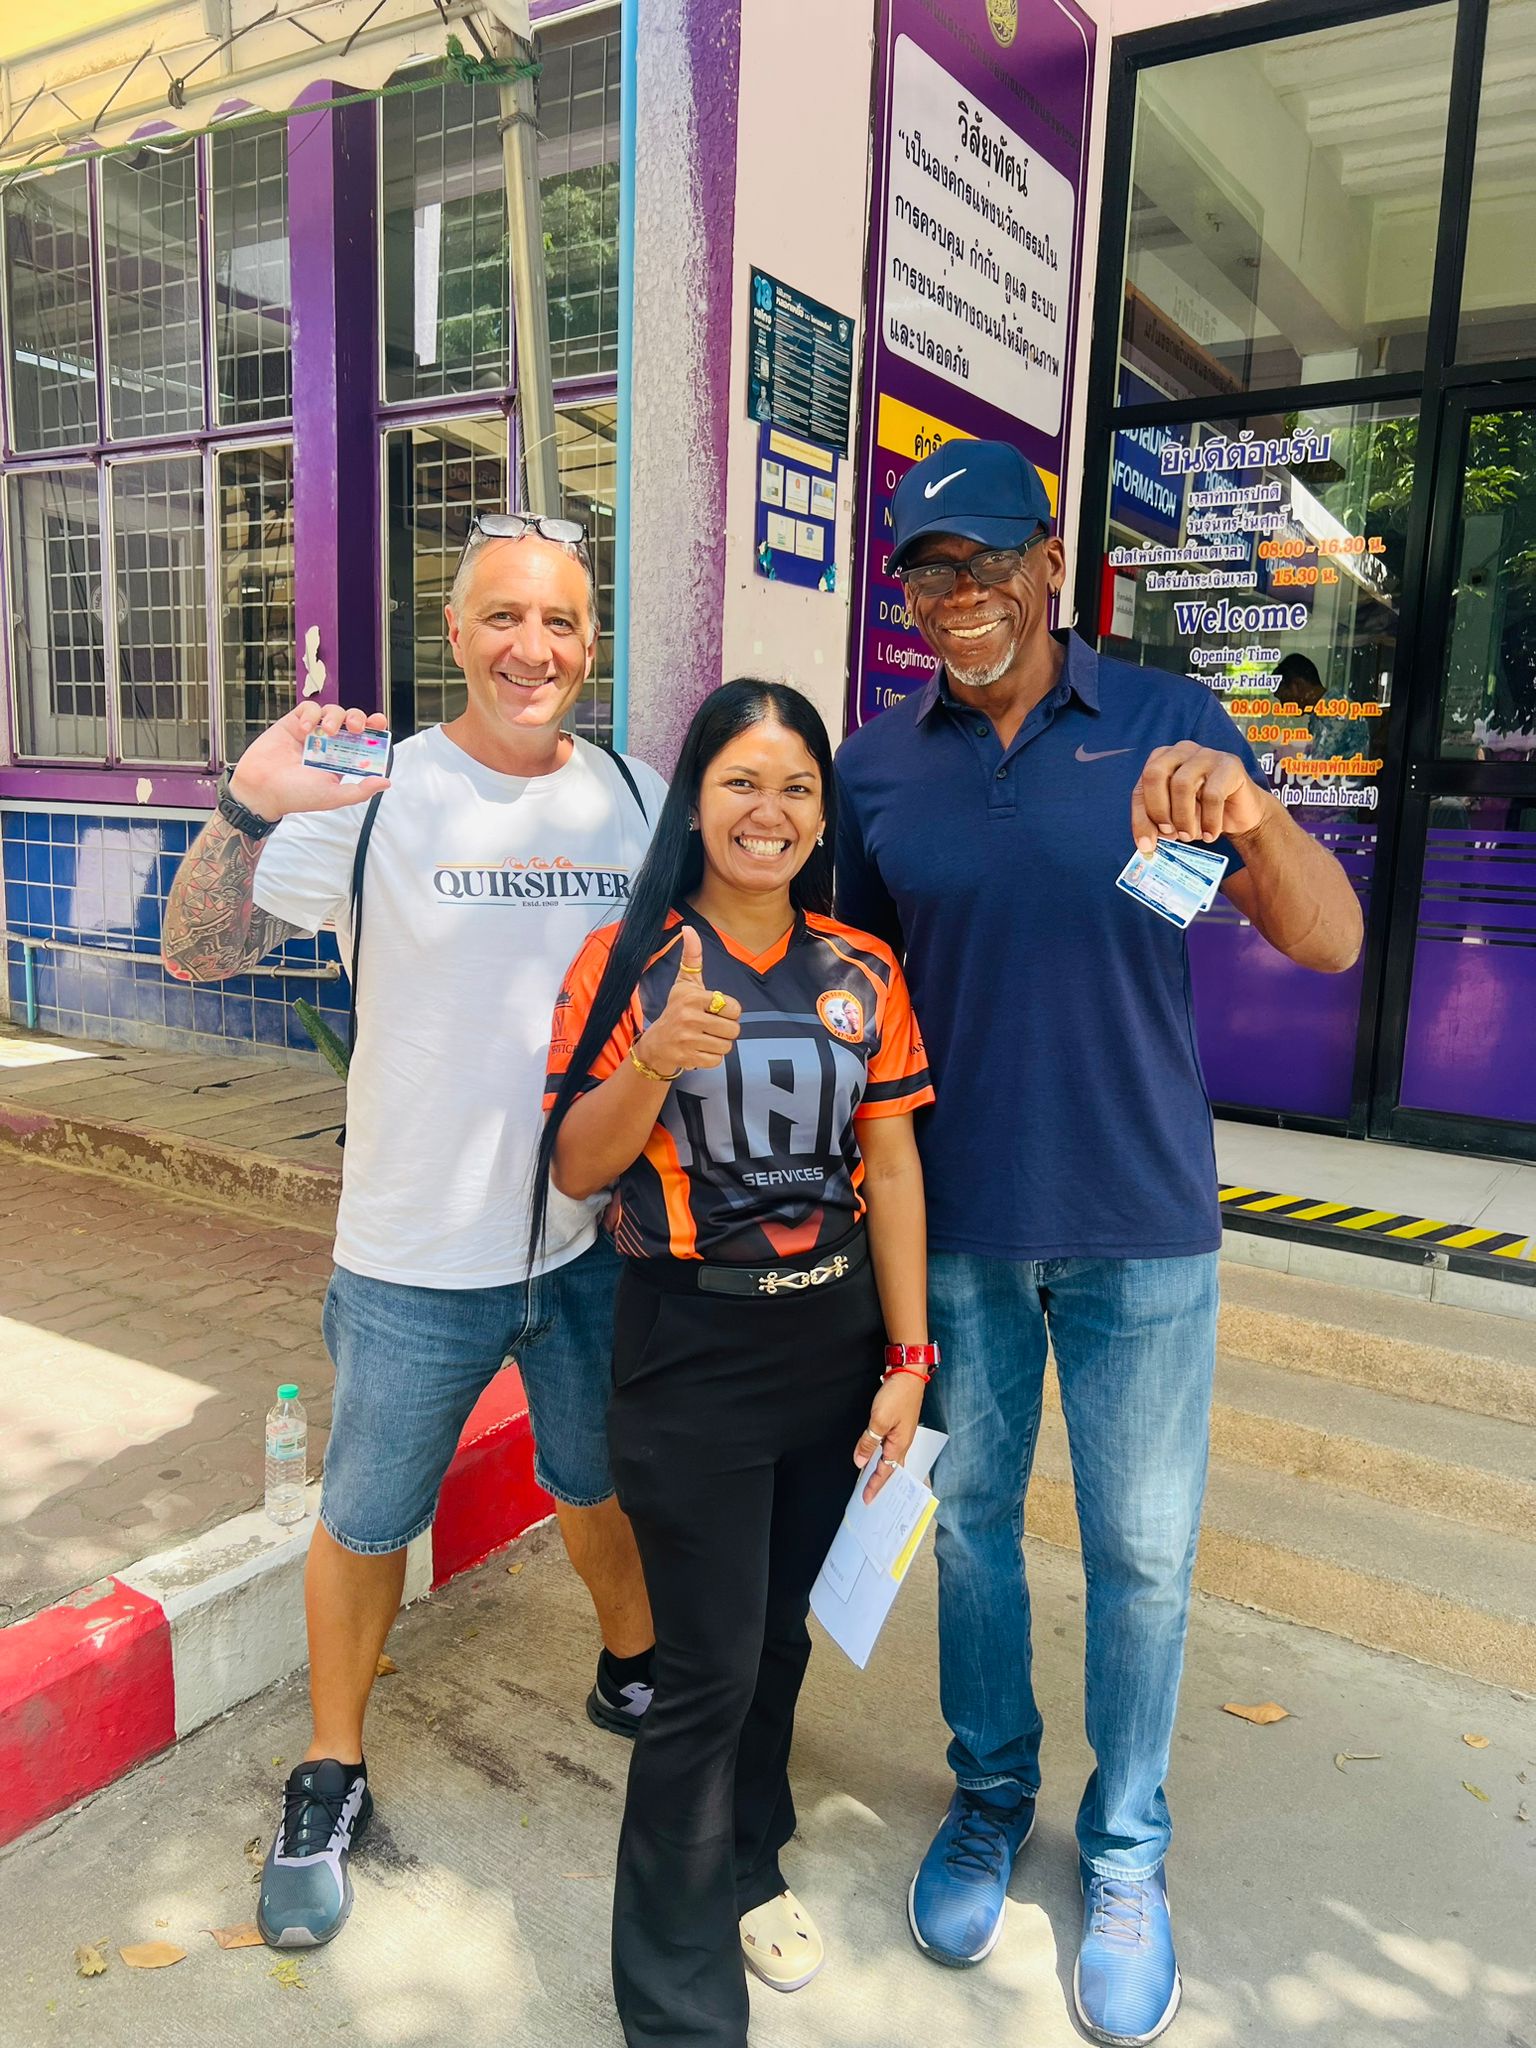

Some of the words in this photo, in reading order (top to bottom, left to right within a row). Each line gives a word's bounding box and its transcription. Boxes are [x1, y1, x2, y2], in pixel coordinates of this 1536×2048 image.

[957, 100, 1029, 198] วิสัยทัศน์
[895, 194, 966, 267] การควบคุม
[969, 244, 1001, 285] กำกับ
[1004, 271, 1027, 305] ดูแล
[1031, 291, 1058, 324] ระบบ
[892, 255, 1060, 378] การขนส่งทางถนนให้มีคุณภาพ
[889, 316, 970, 380] และปลอดภัย
[1161, 428, 1332, 475] ยินดีต้อนรับ
[1188, 483, 1281, 507] เวลาทำการปกติ
[1109, 541, 1245, 567] เปิดให้บริการตั้งแต่เวลา
[1259, 541, 1305, 560] 08.00
[1318, 536, 1366, 556] 16.30
[1368, 536, 1386, 554] น.
[1147, 569, 1257, 591] ปิดรับชำระเงินเวลา
[1273, 567, 1318, 586] 15.30
[1321, 566, 1338, 585] น.
[879, 600, 888, 620] D
[1175, 598, 1307, 634] Welcome
[877, 641, 884, 661] L
[1190, 646, 1243, 667] Opening
[1247, 645, 1280, 662] Time
[875, 686, 882, 706] T
[1231, 700, 1270, 715] 08.00
[1273, 702, 1302, 715] a.m.
[1314, 699, 1348, 715] 4.30
[1350, 702, 1382, 720] p.m.
[1248, 726, 1279, 741] 3.30
[1281, 727, 1312, 744] p.m.
[1282, 785, 1302, 806] (no
[1302, 786, 1337, 806] lunch
[1339, 787, 1378, 810] break)
[433, 869, 631, 898] QUIKSILVER
[742, 1166, 824, 1188] SERVICES
